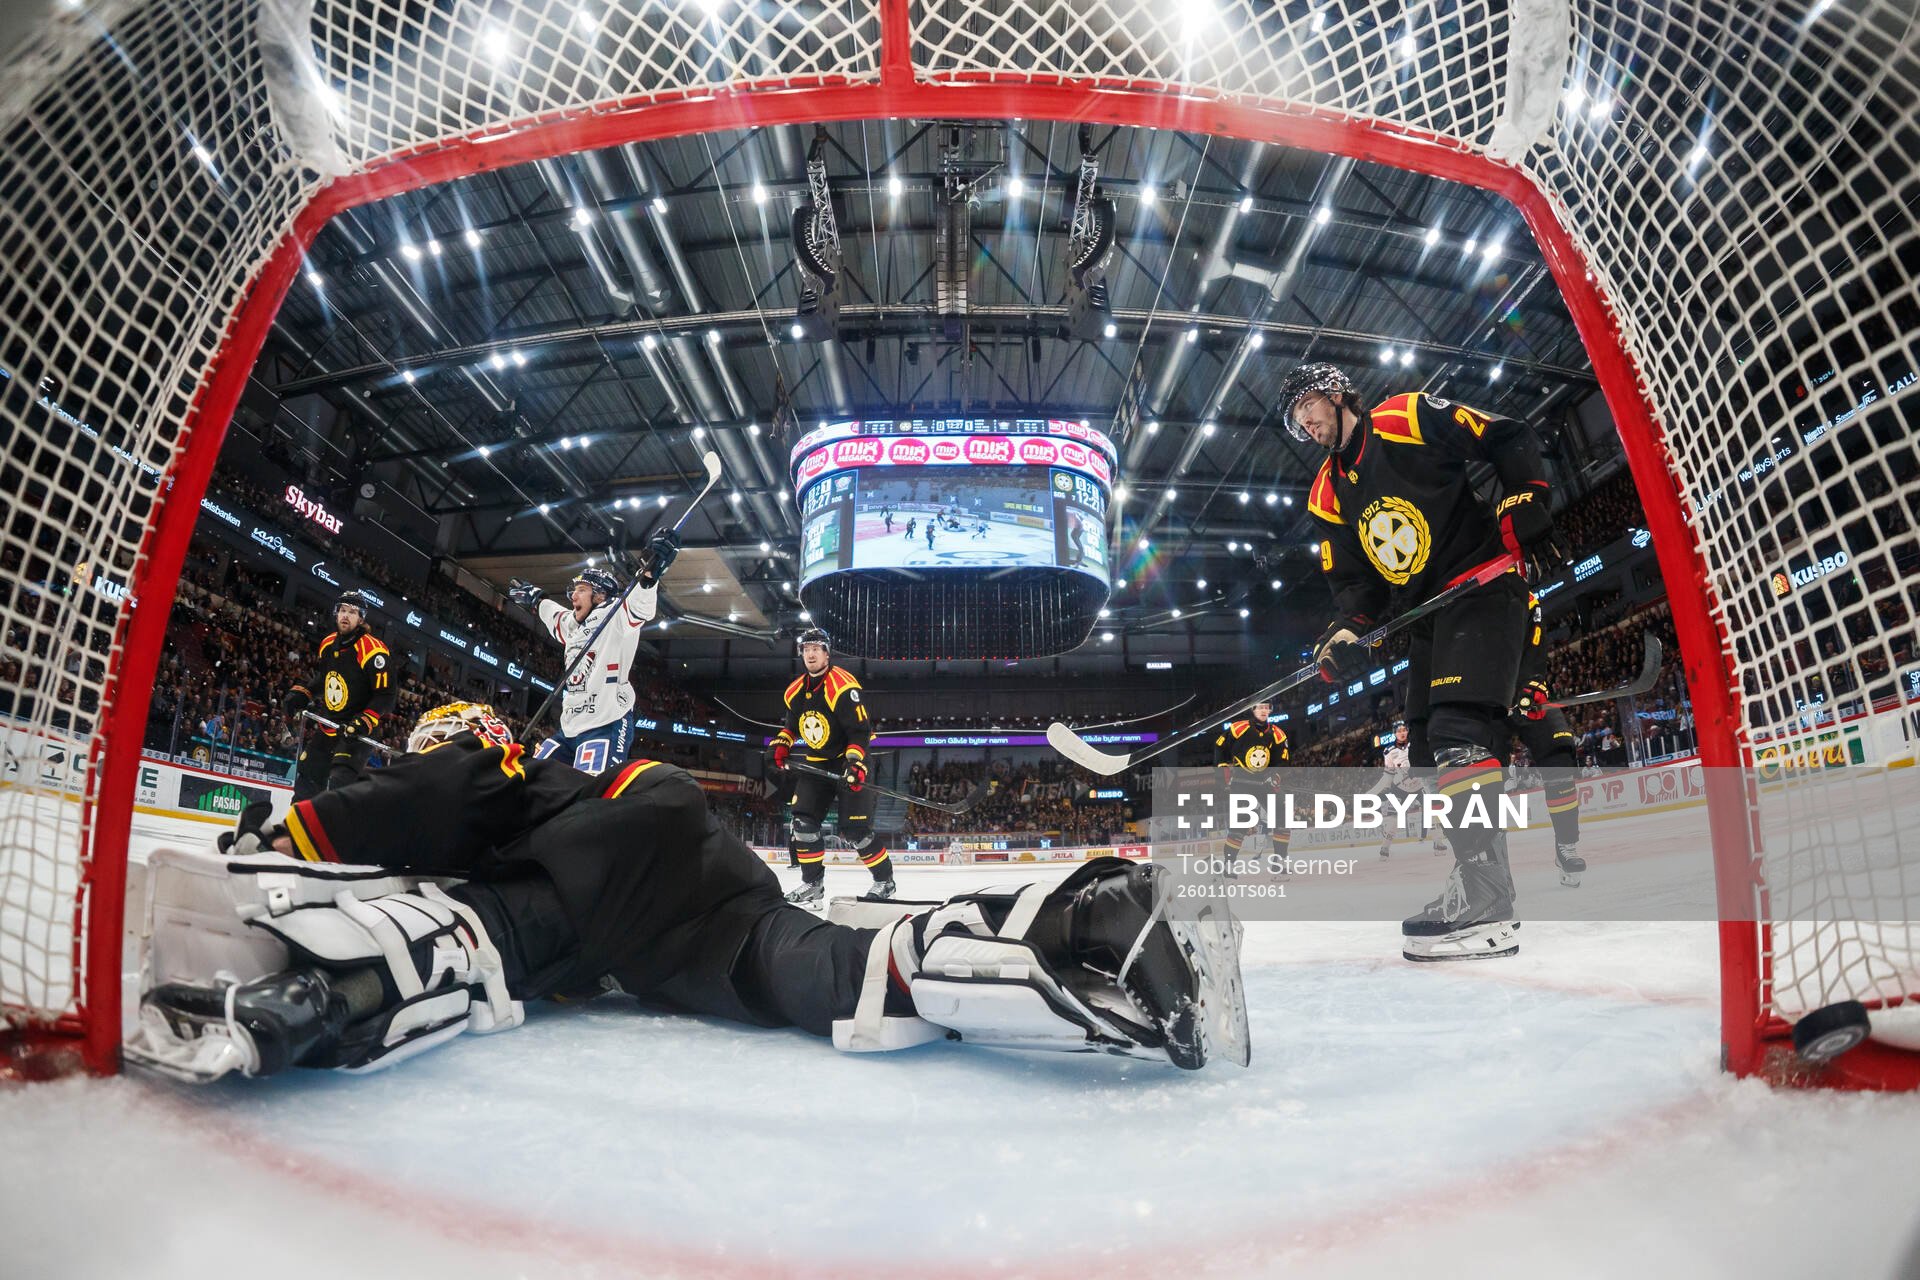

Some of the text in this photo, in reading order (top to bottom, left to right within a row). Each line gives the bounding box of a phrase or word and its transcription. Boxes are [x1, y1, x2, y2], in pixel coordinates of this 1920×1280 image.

[837, 454, 877, 463] MEGAPOL
[893, 454, 925, 462] MEGAPOL
[969, 453, 1009, 462] MEGAPOL
[285, 484, 344, 534] Skybar
[1362, 500, 1381, 521] 1912
[1318, 540, 1334, 572] 9
[1580, 554, 1602, 573] STENA
[1576, 563, 1604, 582] RECYCLING
[1791, 551, 1849, 588] KUSBO
[440, 630, 467, 649] BILBOLAGET
[480, 651, 498, 667] KUSBO
[375, 672, 388, 689] 11
[1430, 676, 1462, 687] BAUER
[969, 737, 988, 746] byter
[1103, 735, 1121, 743] byter
[1098, 790, 1124, 799] KUSBO
[212, 795, 241, 811] PASAB
